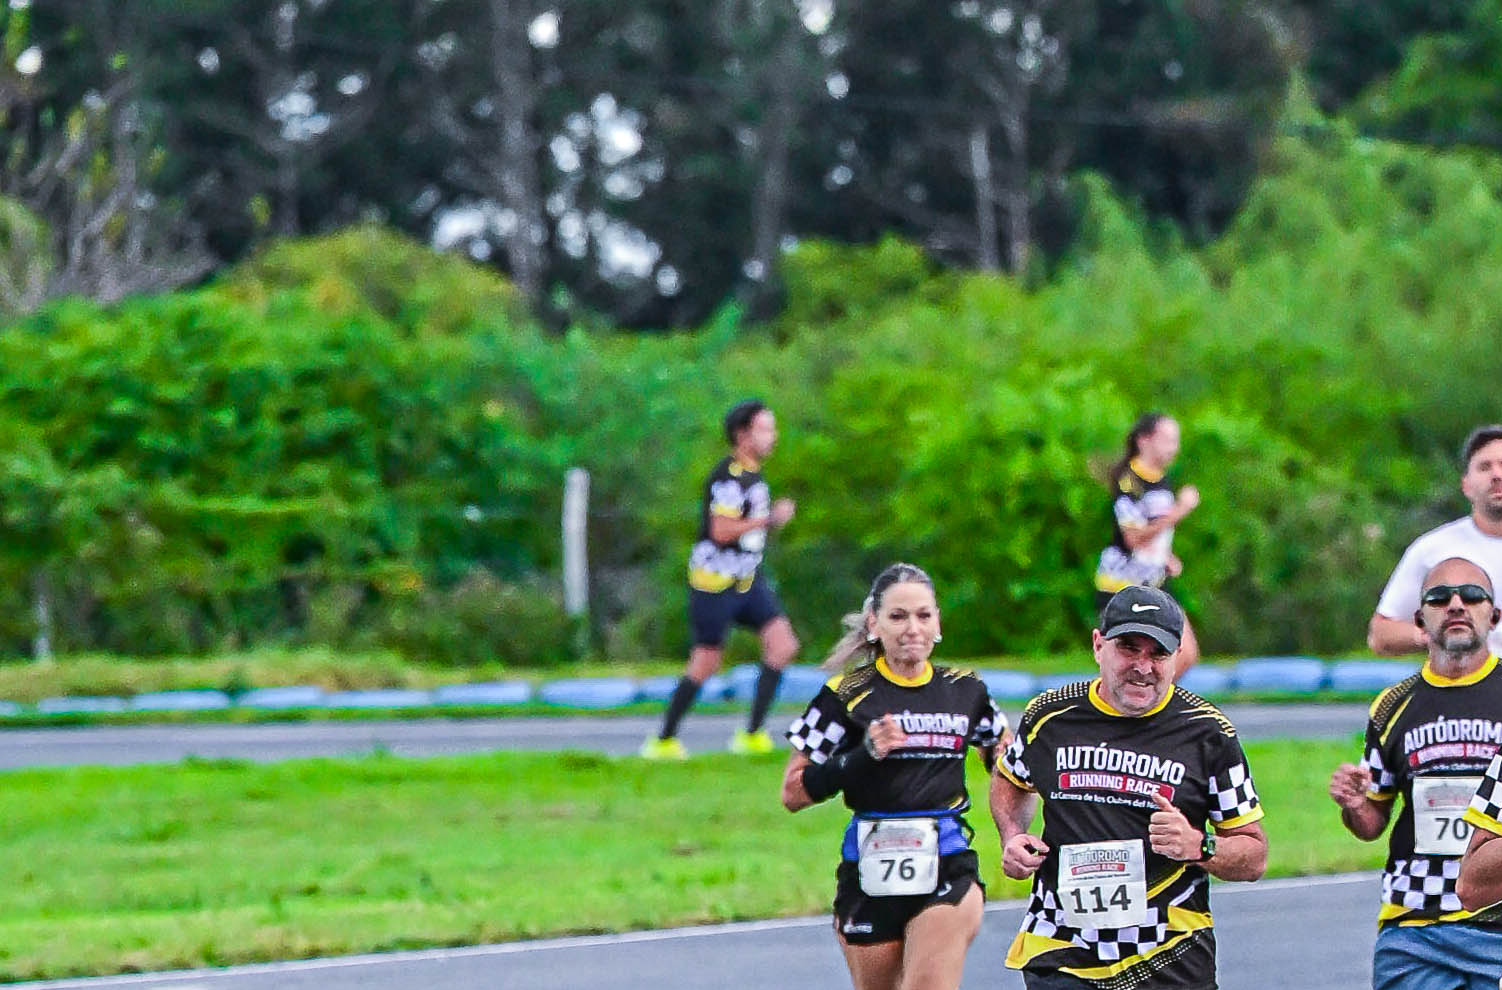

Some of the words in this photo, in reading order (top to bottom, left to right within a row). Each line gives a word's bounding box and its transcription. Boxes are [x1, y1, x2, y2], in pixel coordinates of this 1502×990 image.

[1056, 742, 1186, 785] AUTÓDROMO
[1069, 774, 1124, 789] RUNNING
[1125, 778, 1160, 796] RACE
[1434, 817, 1469, 841] 70
[880, 858, 916, 882] 76
[1070, 884, 1132, 914] 114
